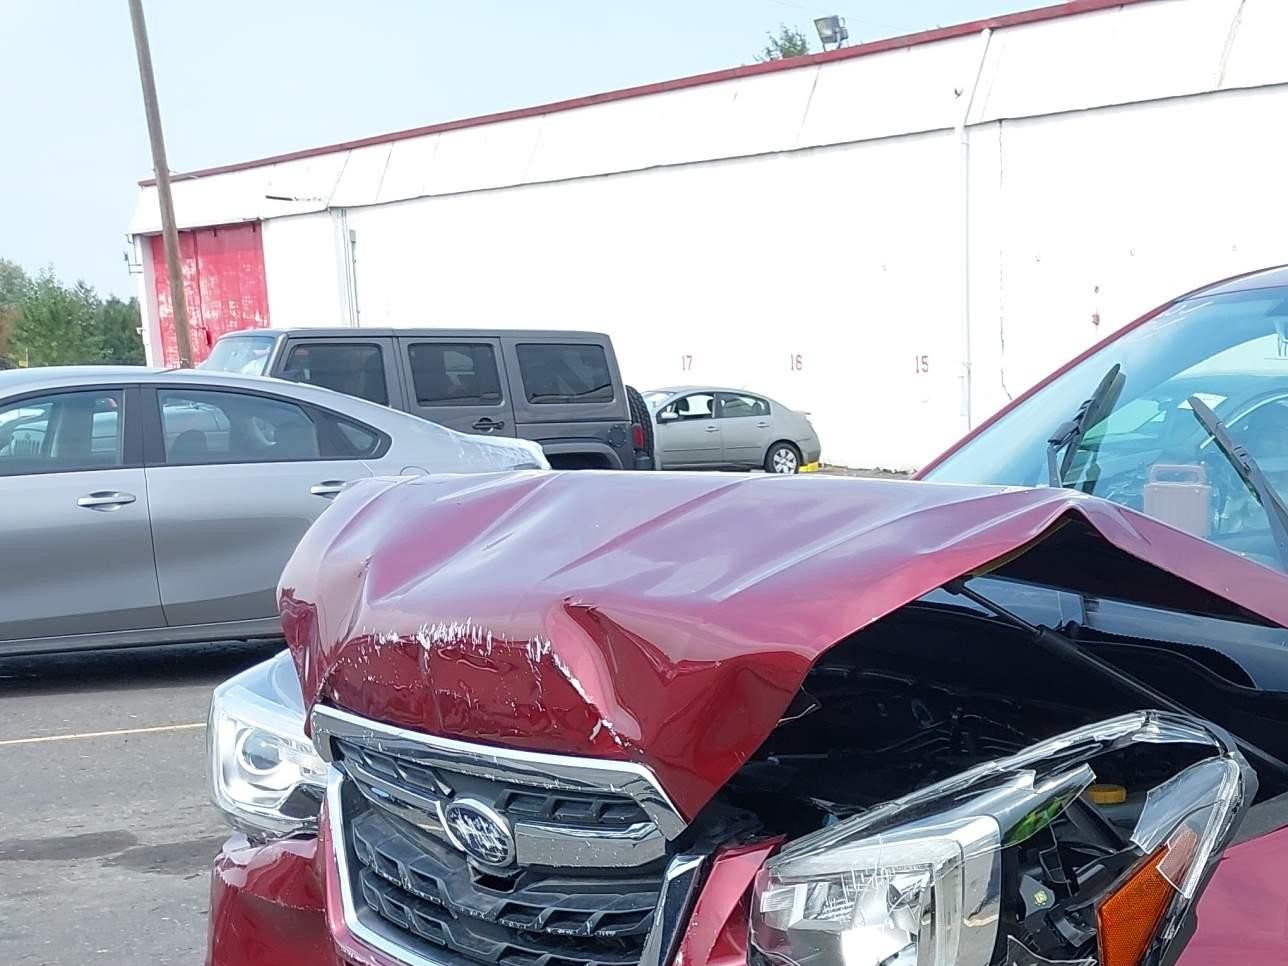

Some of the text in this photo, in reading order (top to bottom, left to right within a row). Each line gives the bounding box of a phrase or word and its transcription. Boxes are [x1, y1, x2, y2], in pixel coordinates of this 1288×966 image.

[681, 355, 693, 371] 17
[790, 354, 803, 371] 16
[915, 355, 929, 374] 15
